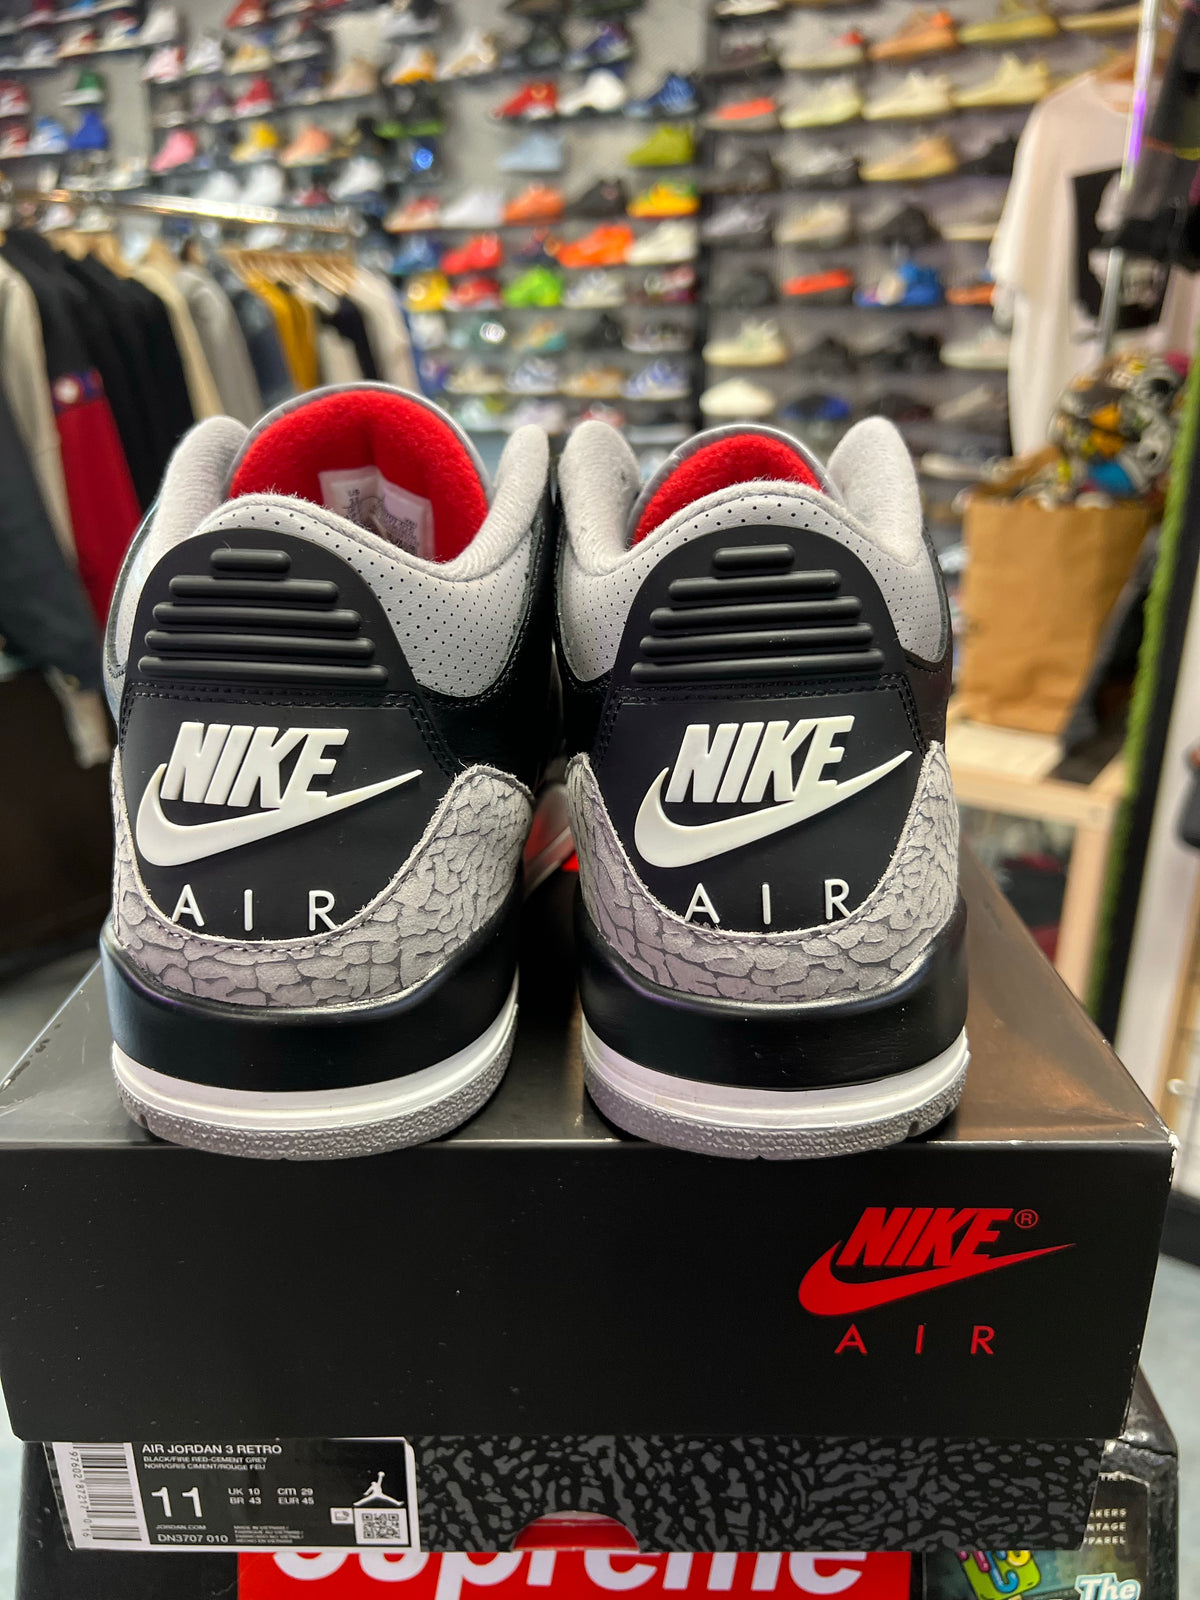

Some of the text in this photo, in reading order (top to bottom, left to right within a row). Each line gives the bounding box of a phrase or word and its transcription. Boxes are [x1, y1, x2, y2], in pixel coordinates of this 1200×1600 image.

[160, 721, 349, 809] NIKE
[665, 715, 855, 803] NIKE
[171, 884, 337, 931] AIR
[684, 878, 851, 925] AIR
[835, 1207, 1014, 1267] NIKE
[834, 1322, 996, 1355] AIR
[142, 1443, 282, 1455] AIR JORDAN 3 RETRO
[151, 1486, 203, 1518] 11
[228, 1487, 244, 1496] UK
[248, 1487, 261, 1495] 10
[301, 1487, 314, 1496] 29
[229, 1496, 315, 1505] BR 43 EUR 45
[157, 1533, 204, 1543] DN3707
[206, 1534, 229, 1544] 010
